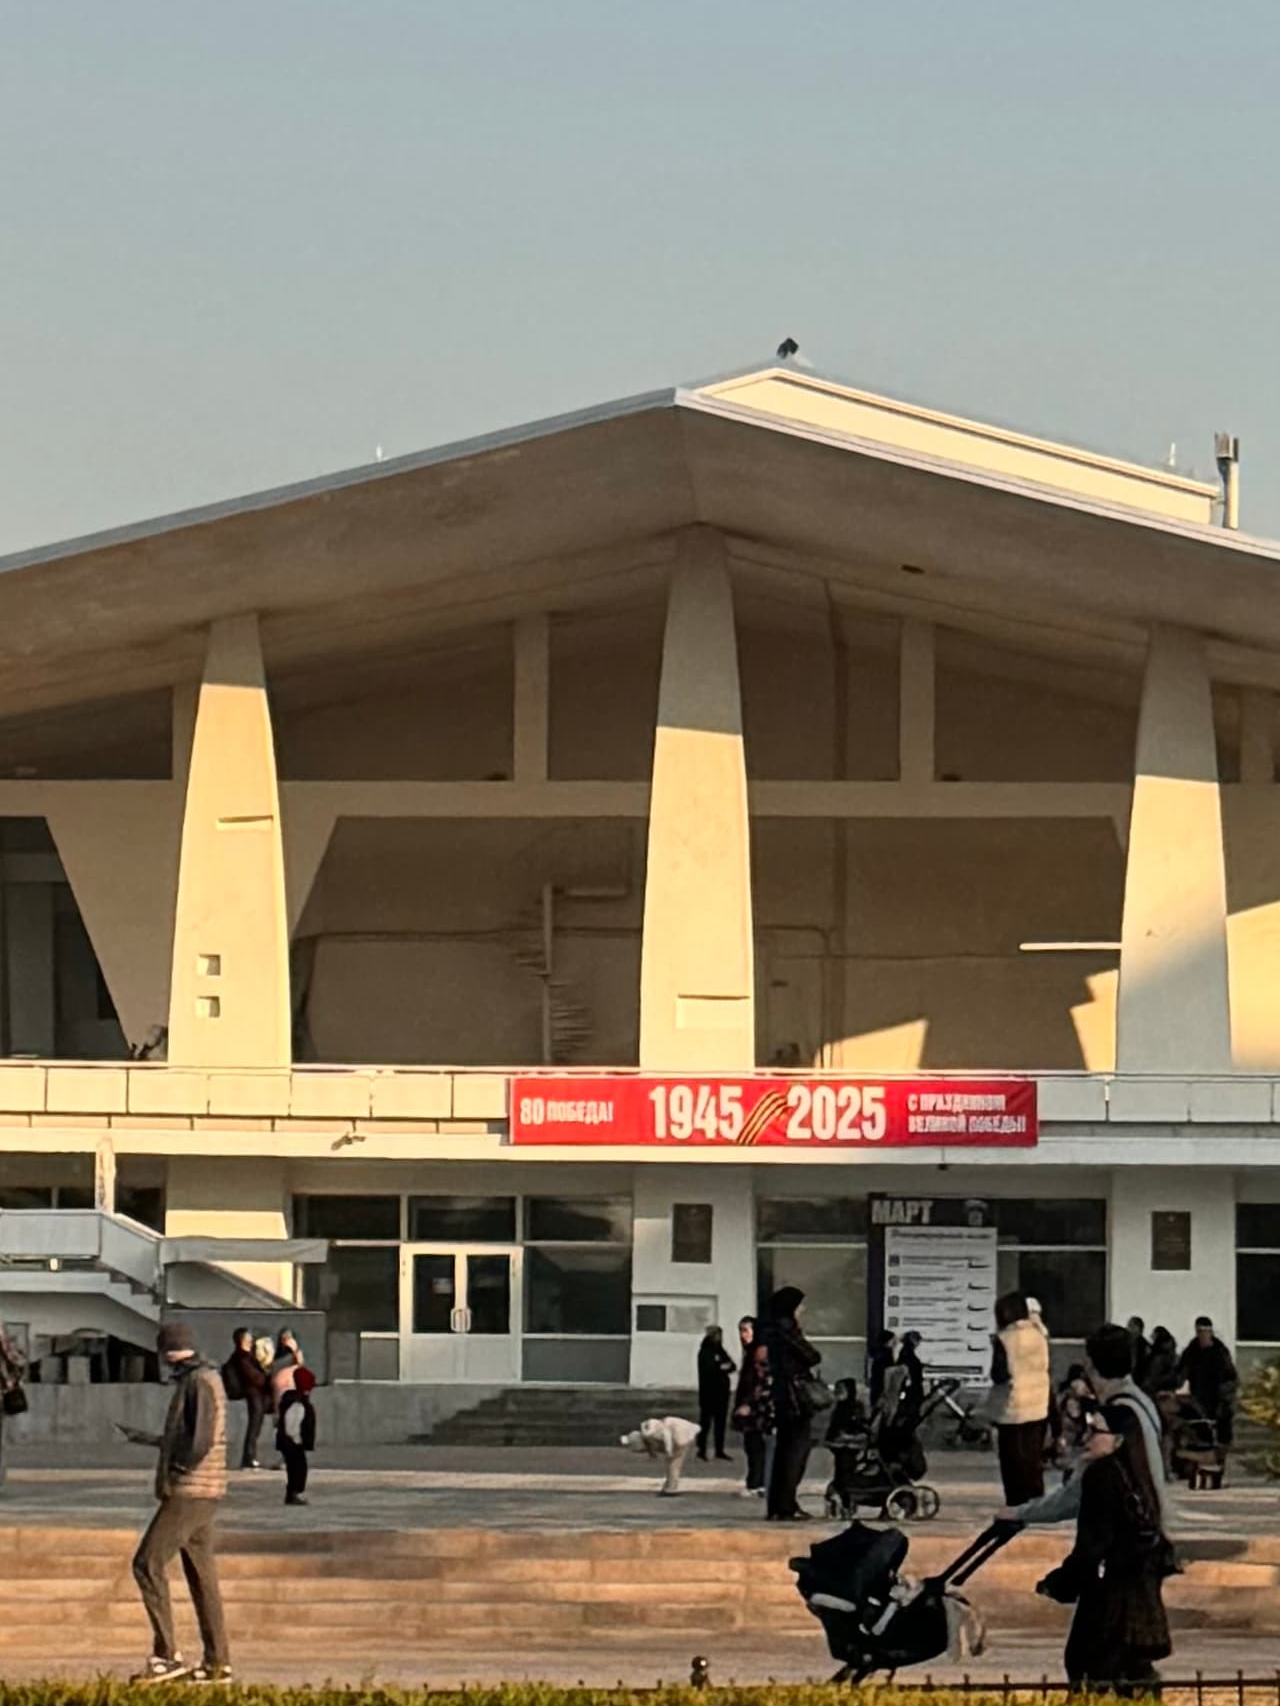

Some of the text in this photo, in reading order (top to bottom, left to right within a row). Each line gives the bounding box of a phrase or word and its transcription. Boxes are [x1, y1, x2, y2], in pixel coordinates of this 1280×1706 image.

[520, 1097, 545, 1125] 80
[649, 1084, 886, 1140] 1945 2025
[872, 1200, 933, 1224] МАРТ
